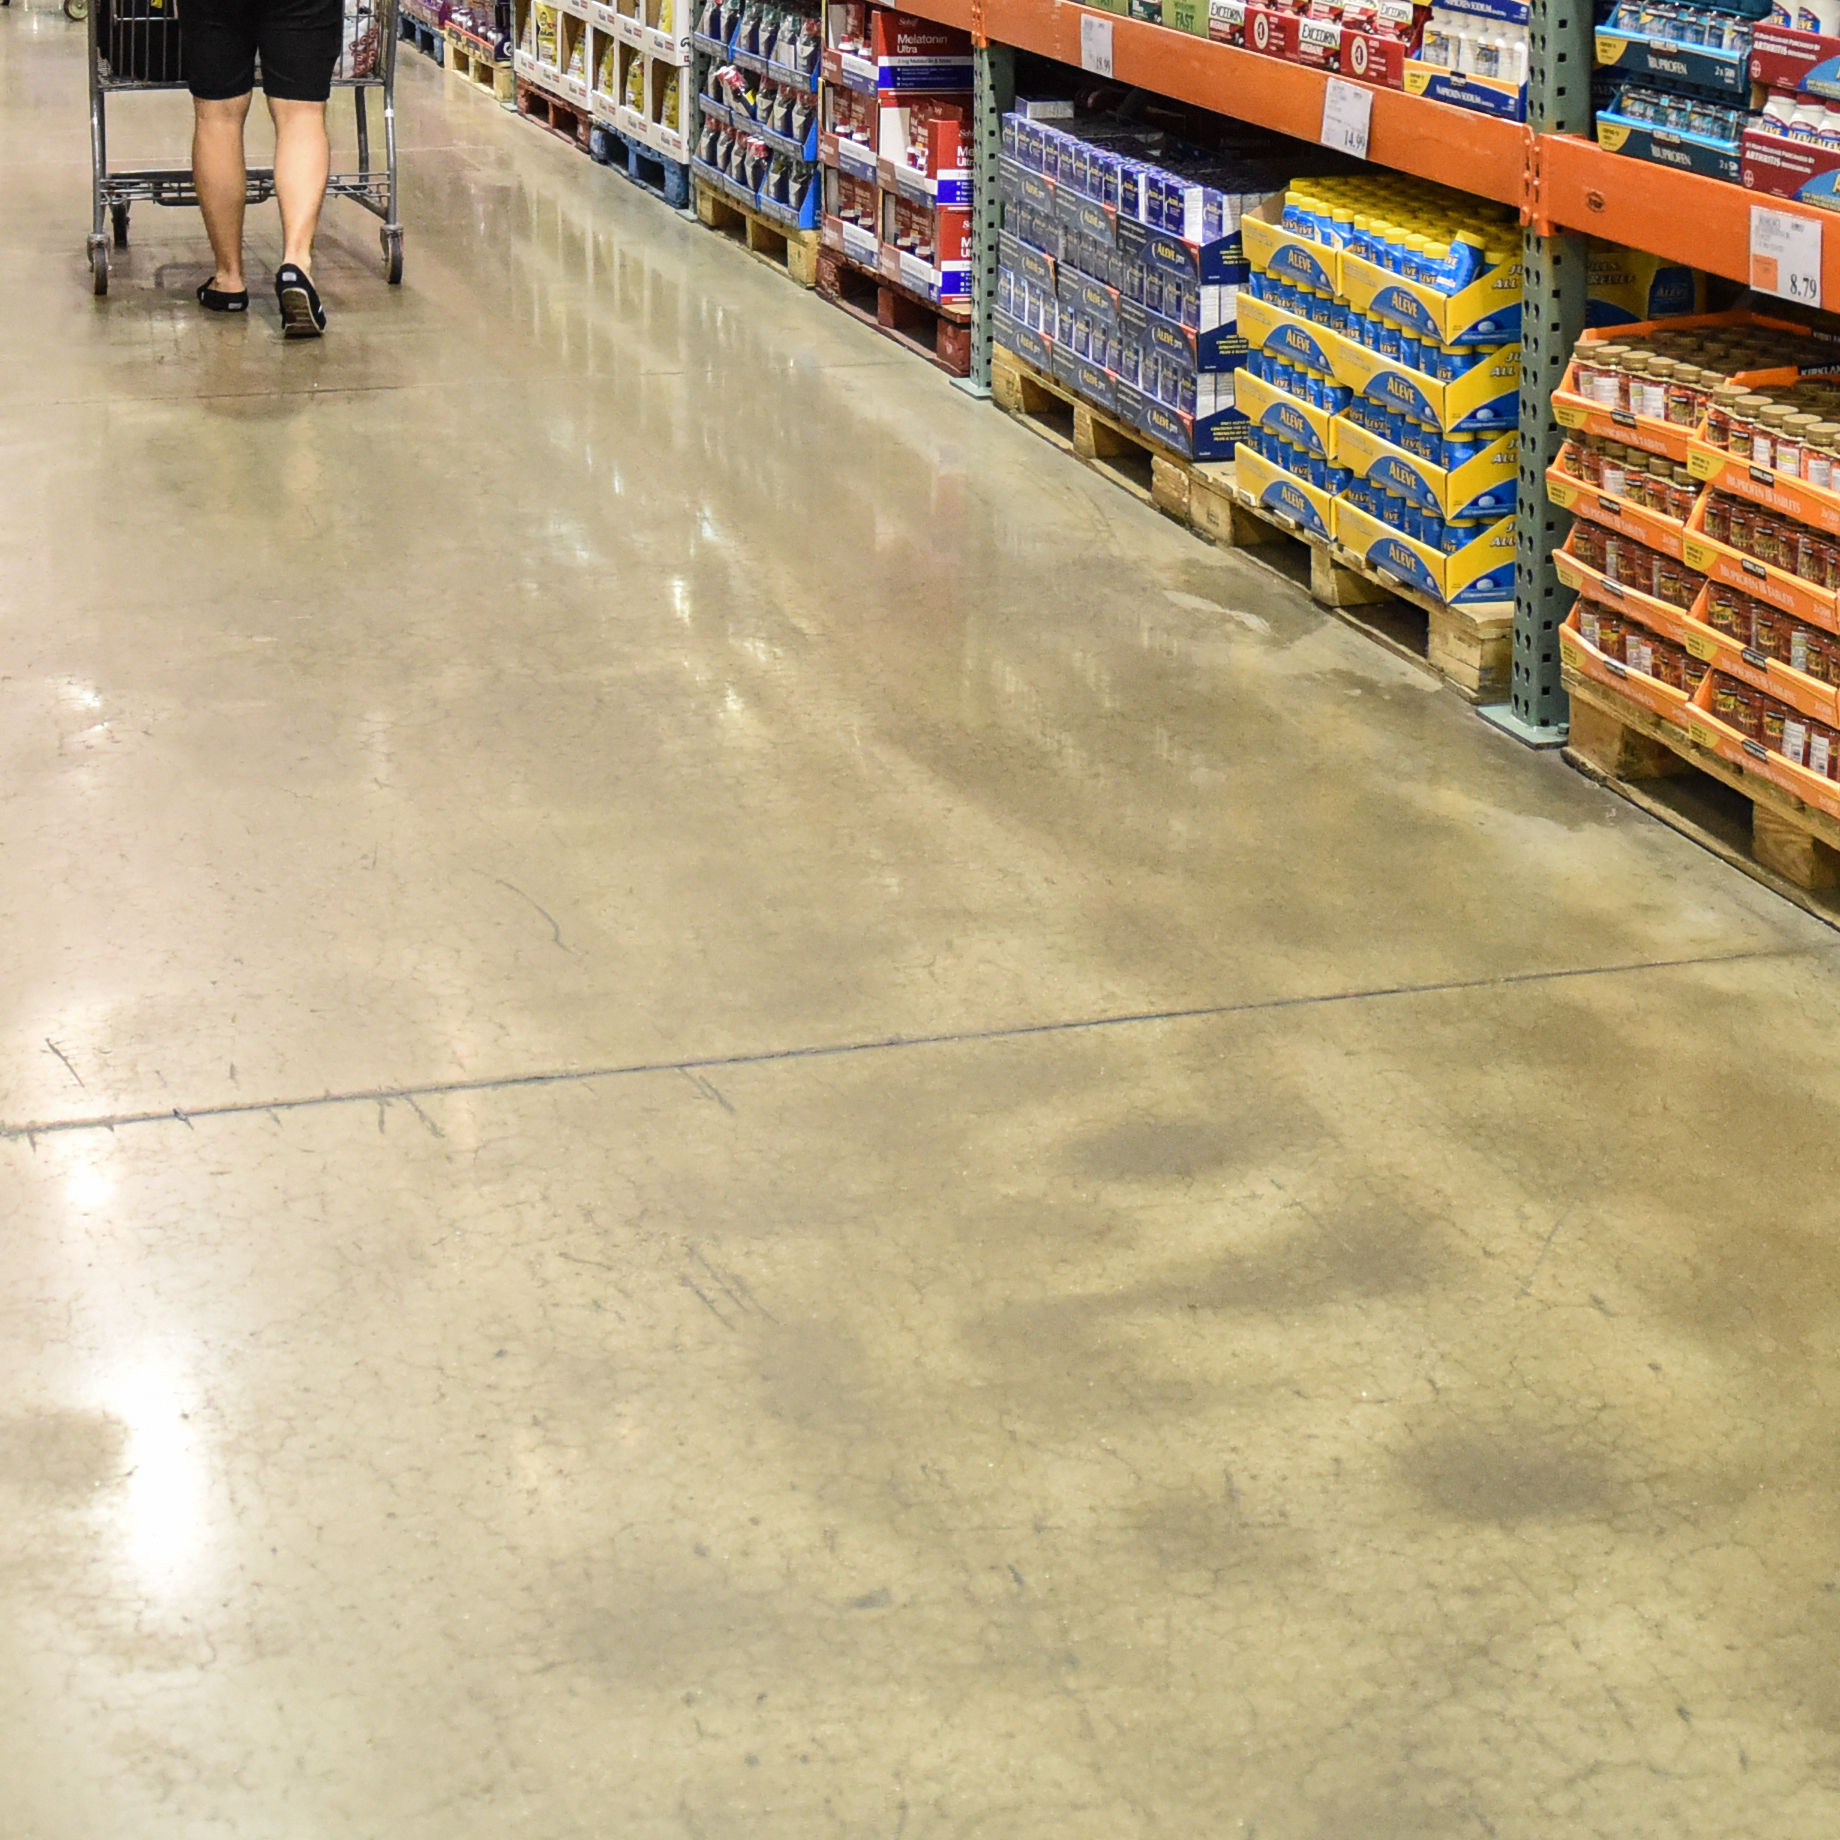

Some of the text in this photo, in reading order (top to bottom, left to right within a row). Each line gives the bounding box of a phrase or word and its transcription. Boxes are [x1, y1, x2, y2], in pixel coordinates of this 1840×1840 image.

[1175, 11, 1195, 29] FAST
[897, 34, 948, 44] Melatonin
[897, 44, 918, 54] Ultra
[1302, 24, 1341, 49] EXCEDRIN
[1790, 272, 1818, 300] 8.79
[1391, 292, 1419, 318] ALEVE
[1388, 461, 1417, 490] ALEVE
